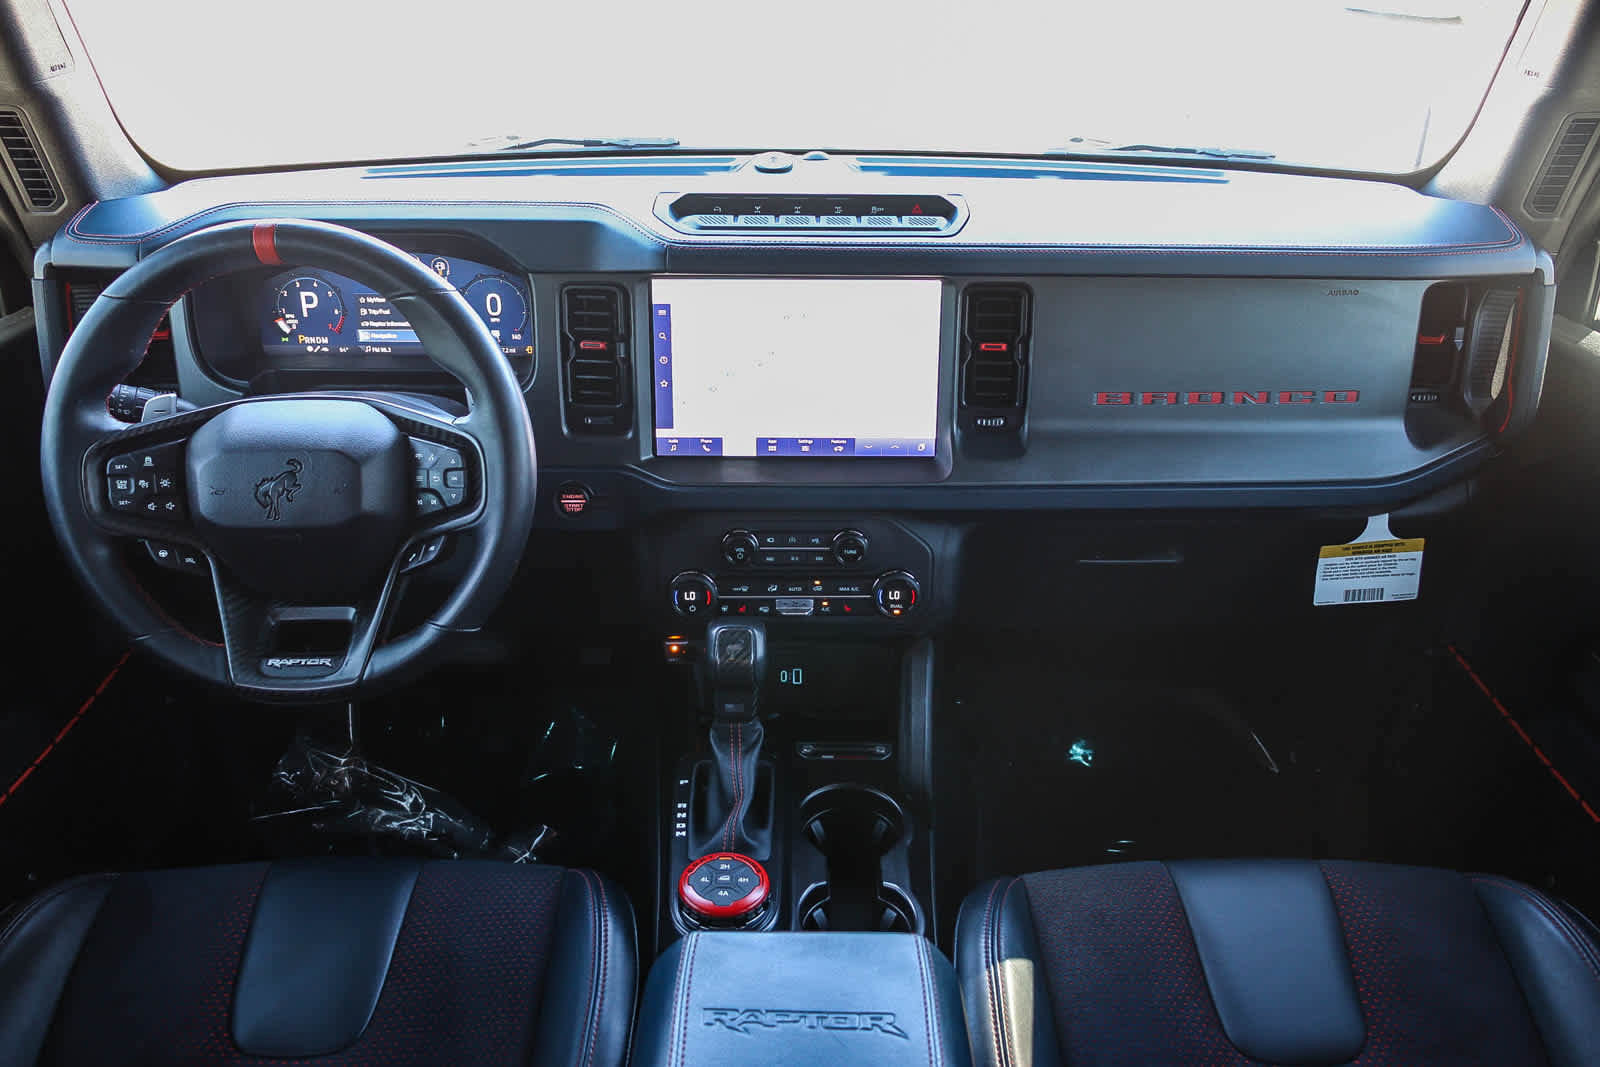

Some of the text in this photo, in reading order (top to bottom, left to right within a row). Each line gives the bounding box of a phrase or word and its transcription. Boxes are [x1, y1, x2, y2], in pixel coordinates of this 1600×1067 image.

[300, 291, 318, 317] P
[486, 293, 502, 316] 0
[1095, 390, 1360, 406] BRONCO
[684, 591, 697, 601] LO
[888, 590, 901, 601] LO
[266, 658, 332, 668] RAPTOR
[703, 1007, 910, 1040] RAPTOR
